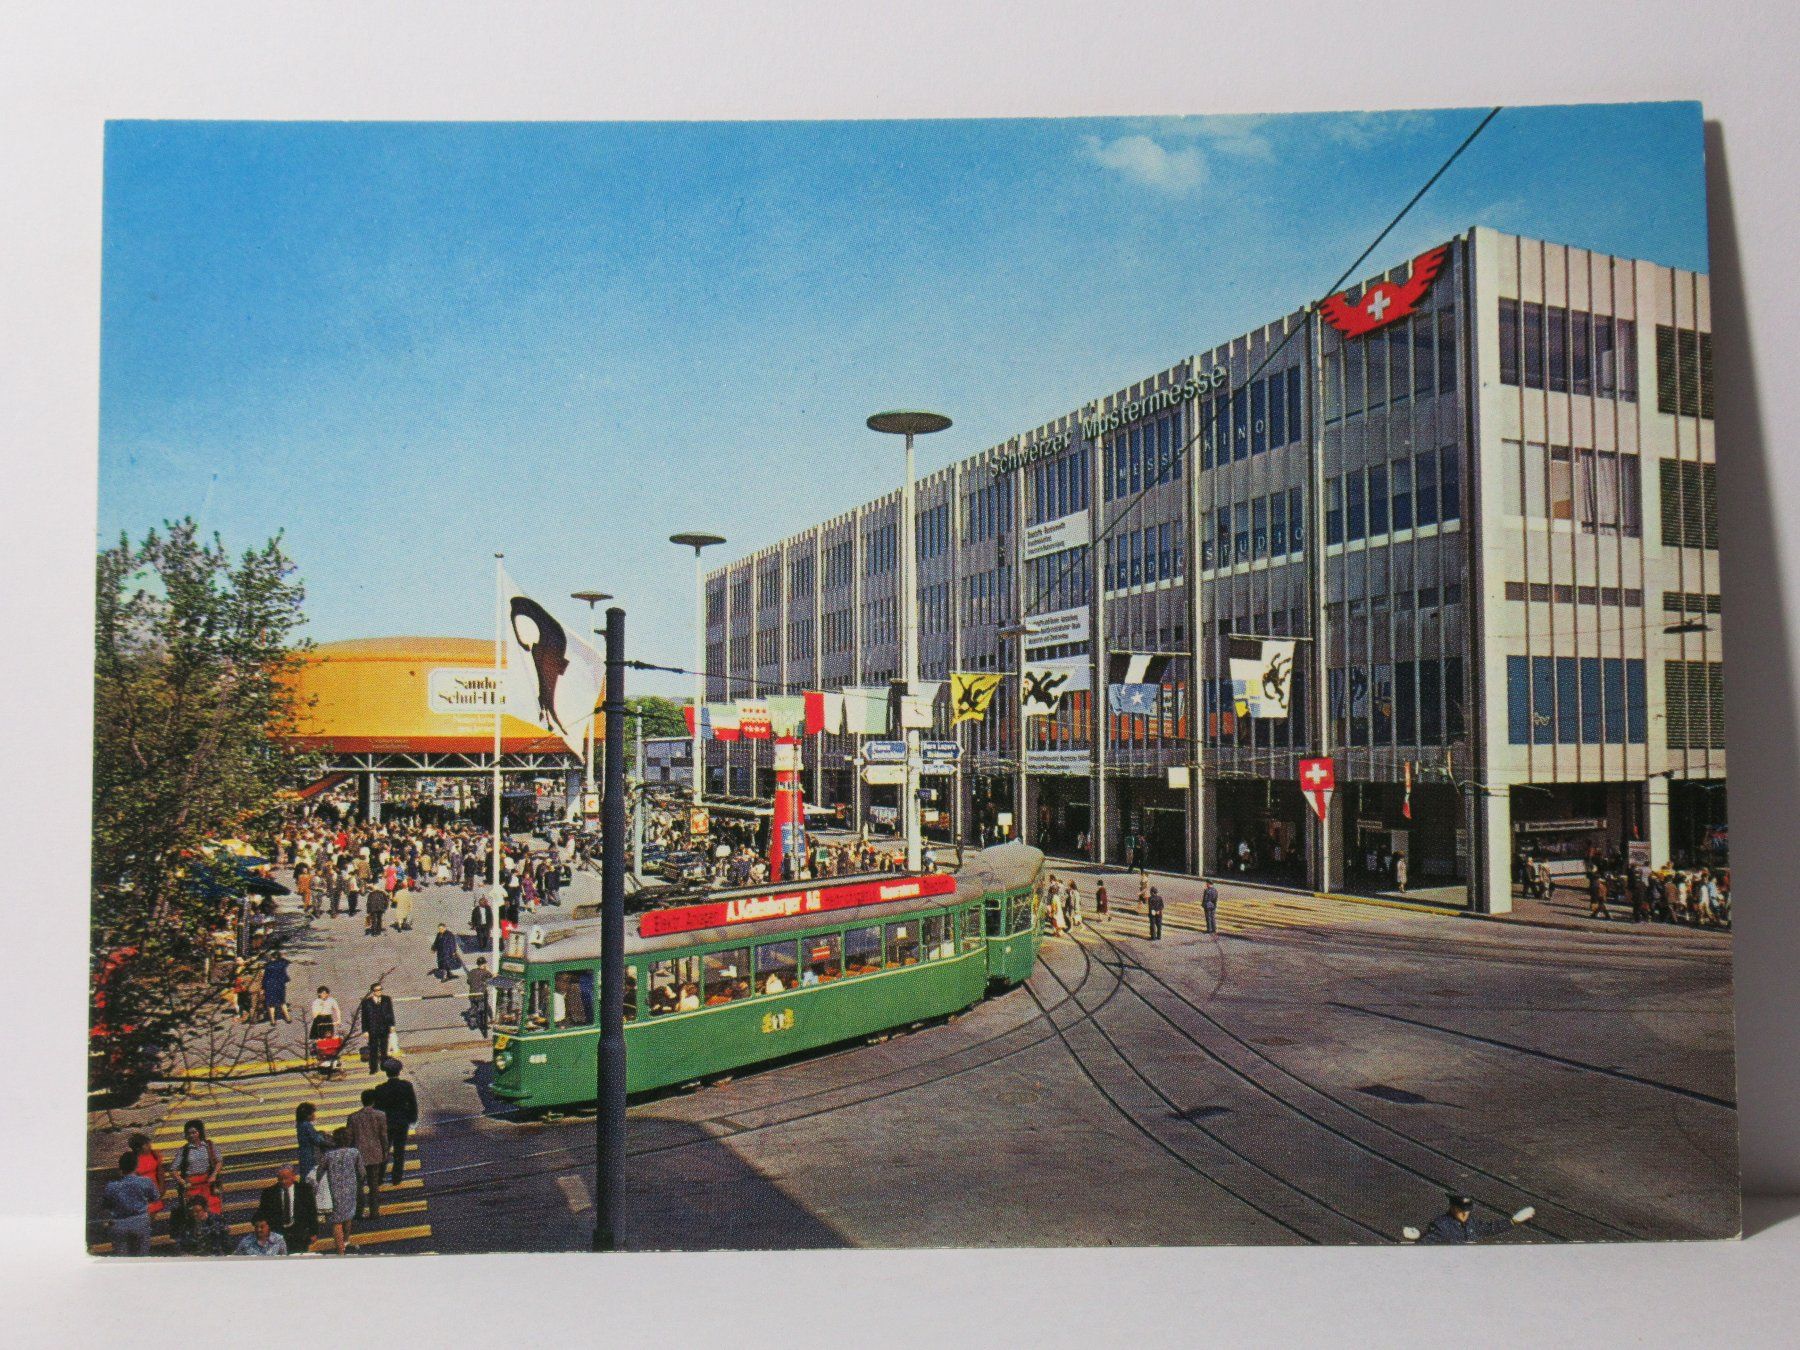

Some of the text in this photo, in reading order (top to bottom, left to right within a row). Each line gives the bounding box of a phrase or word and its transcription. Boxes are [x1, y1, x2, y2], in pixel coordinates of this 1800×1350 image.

[989, 365, 1227, 477] Schweizer Mustermesse
[1204, 419, 1264, 452] KINO
[1206, 527, 1303, 561] STUDIO
